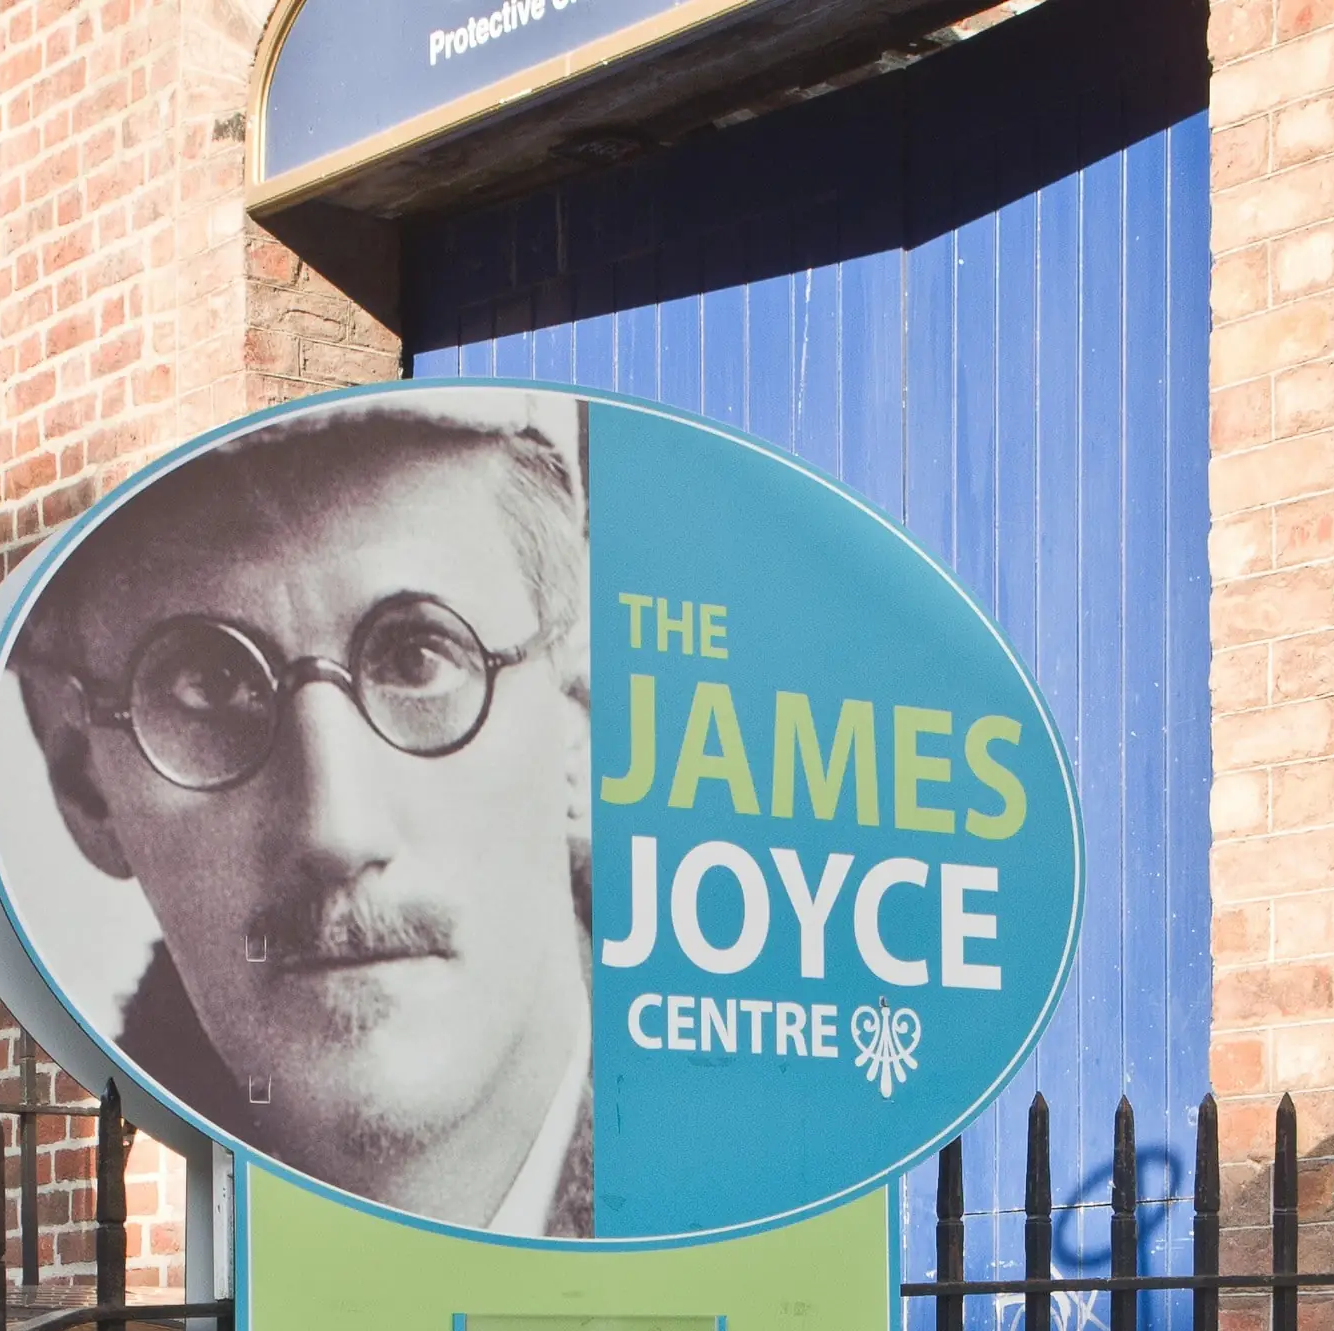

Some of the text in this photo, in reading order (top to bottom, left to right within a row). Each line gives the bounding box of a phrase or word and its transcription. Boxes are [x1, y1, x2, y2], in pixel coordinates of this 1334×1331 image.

[429, 0, 545, 66] Protective
[618, 591, 729, 660] THE
[599, 673, 1028, 840] JAMES
[601, 834, 1003, 991] JOYCE
[627, 993, 839, 1059] CENTRE
